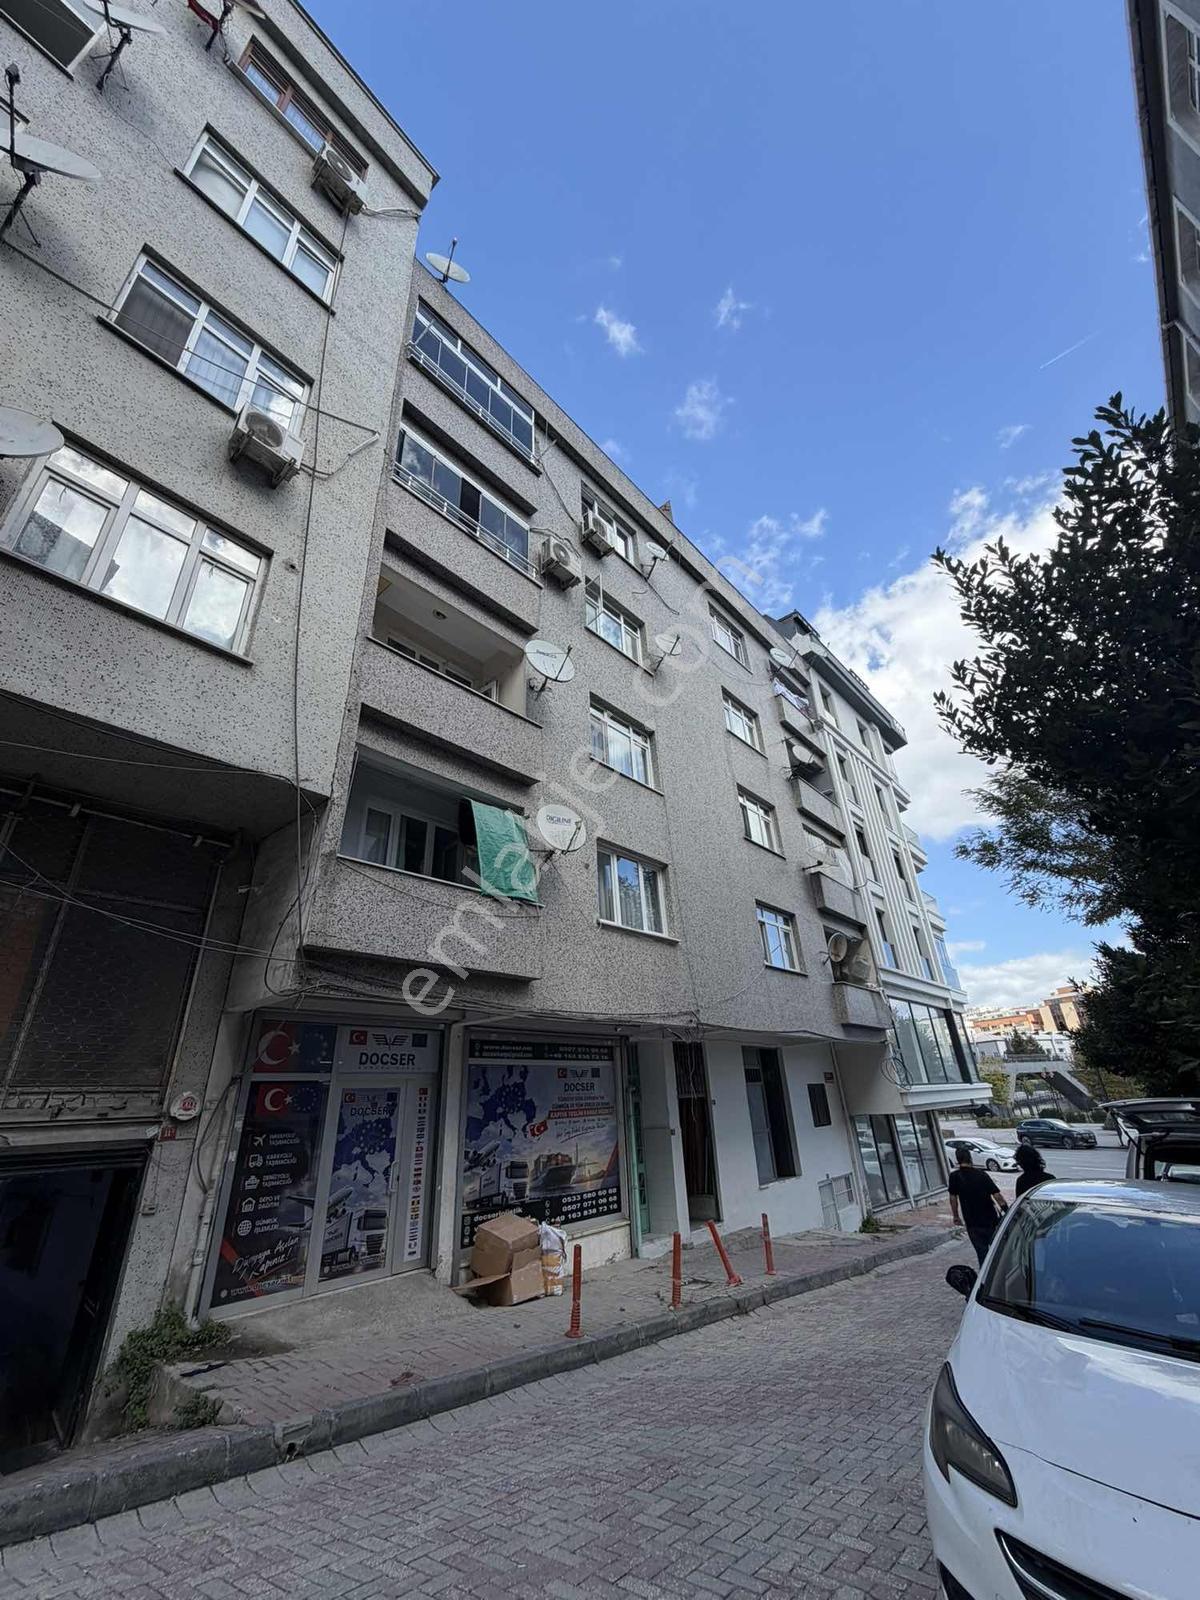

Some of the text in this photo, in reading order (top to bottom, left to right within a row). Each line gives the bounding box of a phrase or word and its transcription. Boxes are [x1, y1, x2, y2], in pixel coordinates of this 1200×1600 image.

[359, 1052, 416, 1066] DOCSER
[564, 1082, 595, 1092] DOCSER
[350, 1106, 390, 1117] DOCSER
